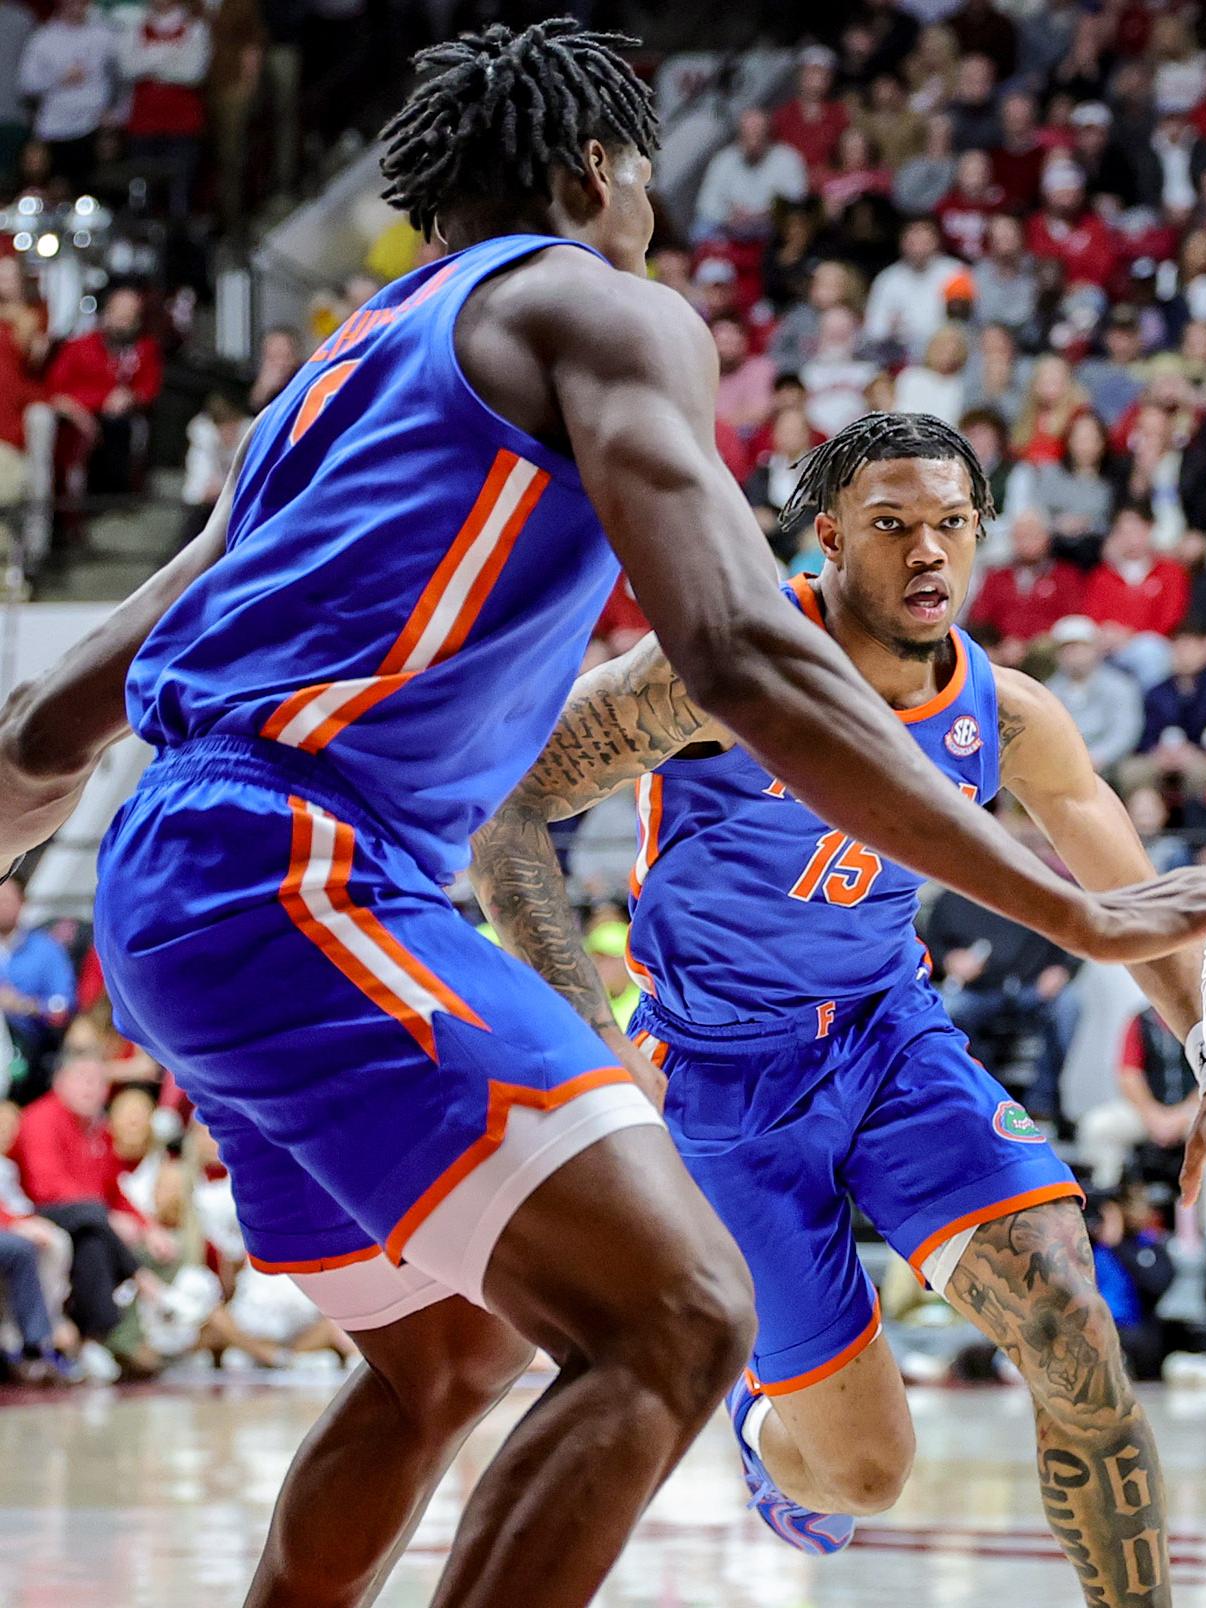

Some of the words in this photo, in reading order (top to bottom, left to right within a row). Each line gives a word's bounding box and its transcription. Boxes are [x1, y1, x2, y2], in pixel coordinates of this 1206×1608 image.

[953, 718, 977, 746] SEC
[787, 829, 883, 907] 15
[815, 1000, 836, 1039] F
